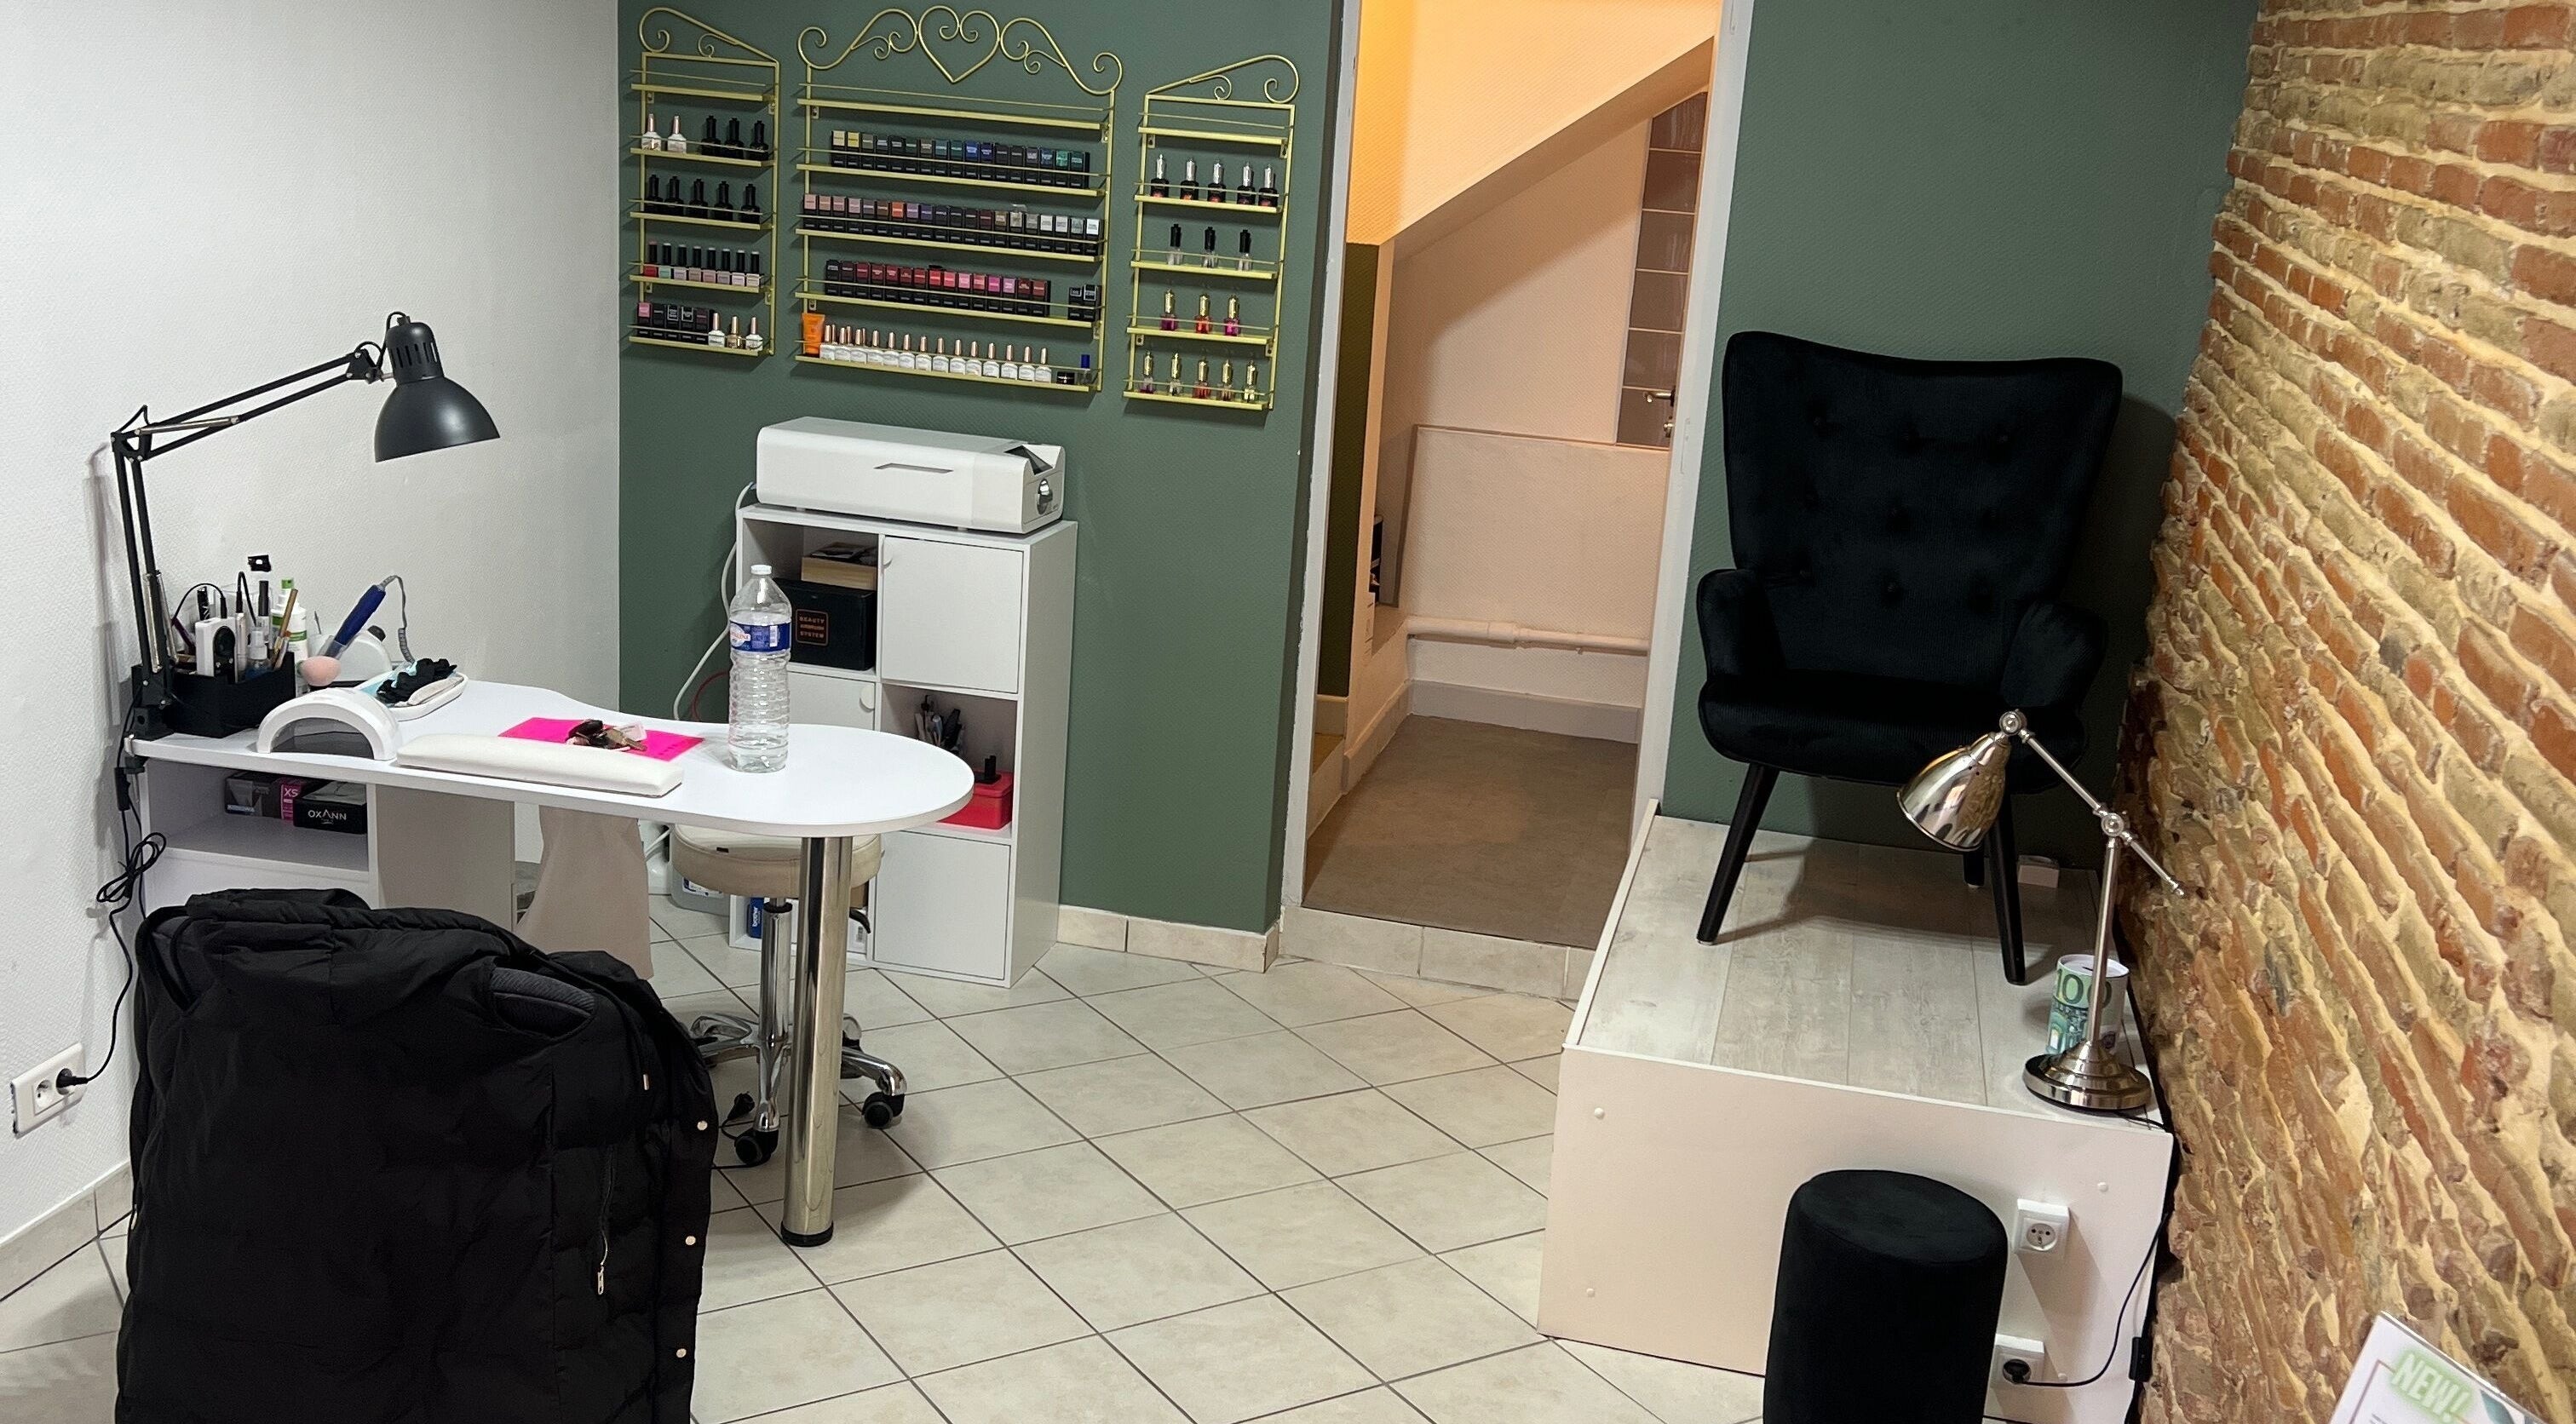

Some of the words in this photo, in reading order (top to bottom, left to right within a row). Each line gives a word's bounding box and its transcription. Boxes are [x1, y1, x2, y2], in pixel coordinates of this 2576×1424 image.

[284, 788, 298, 798] XS
[308, 809, 347, 821] OXANN
[2391, 1352, 2470, 1421] NEW!
